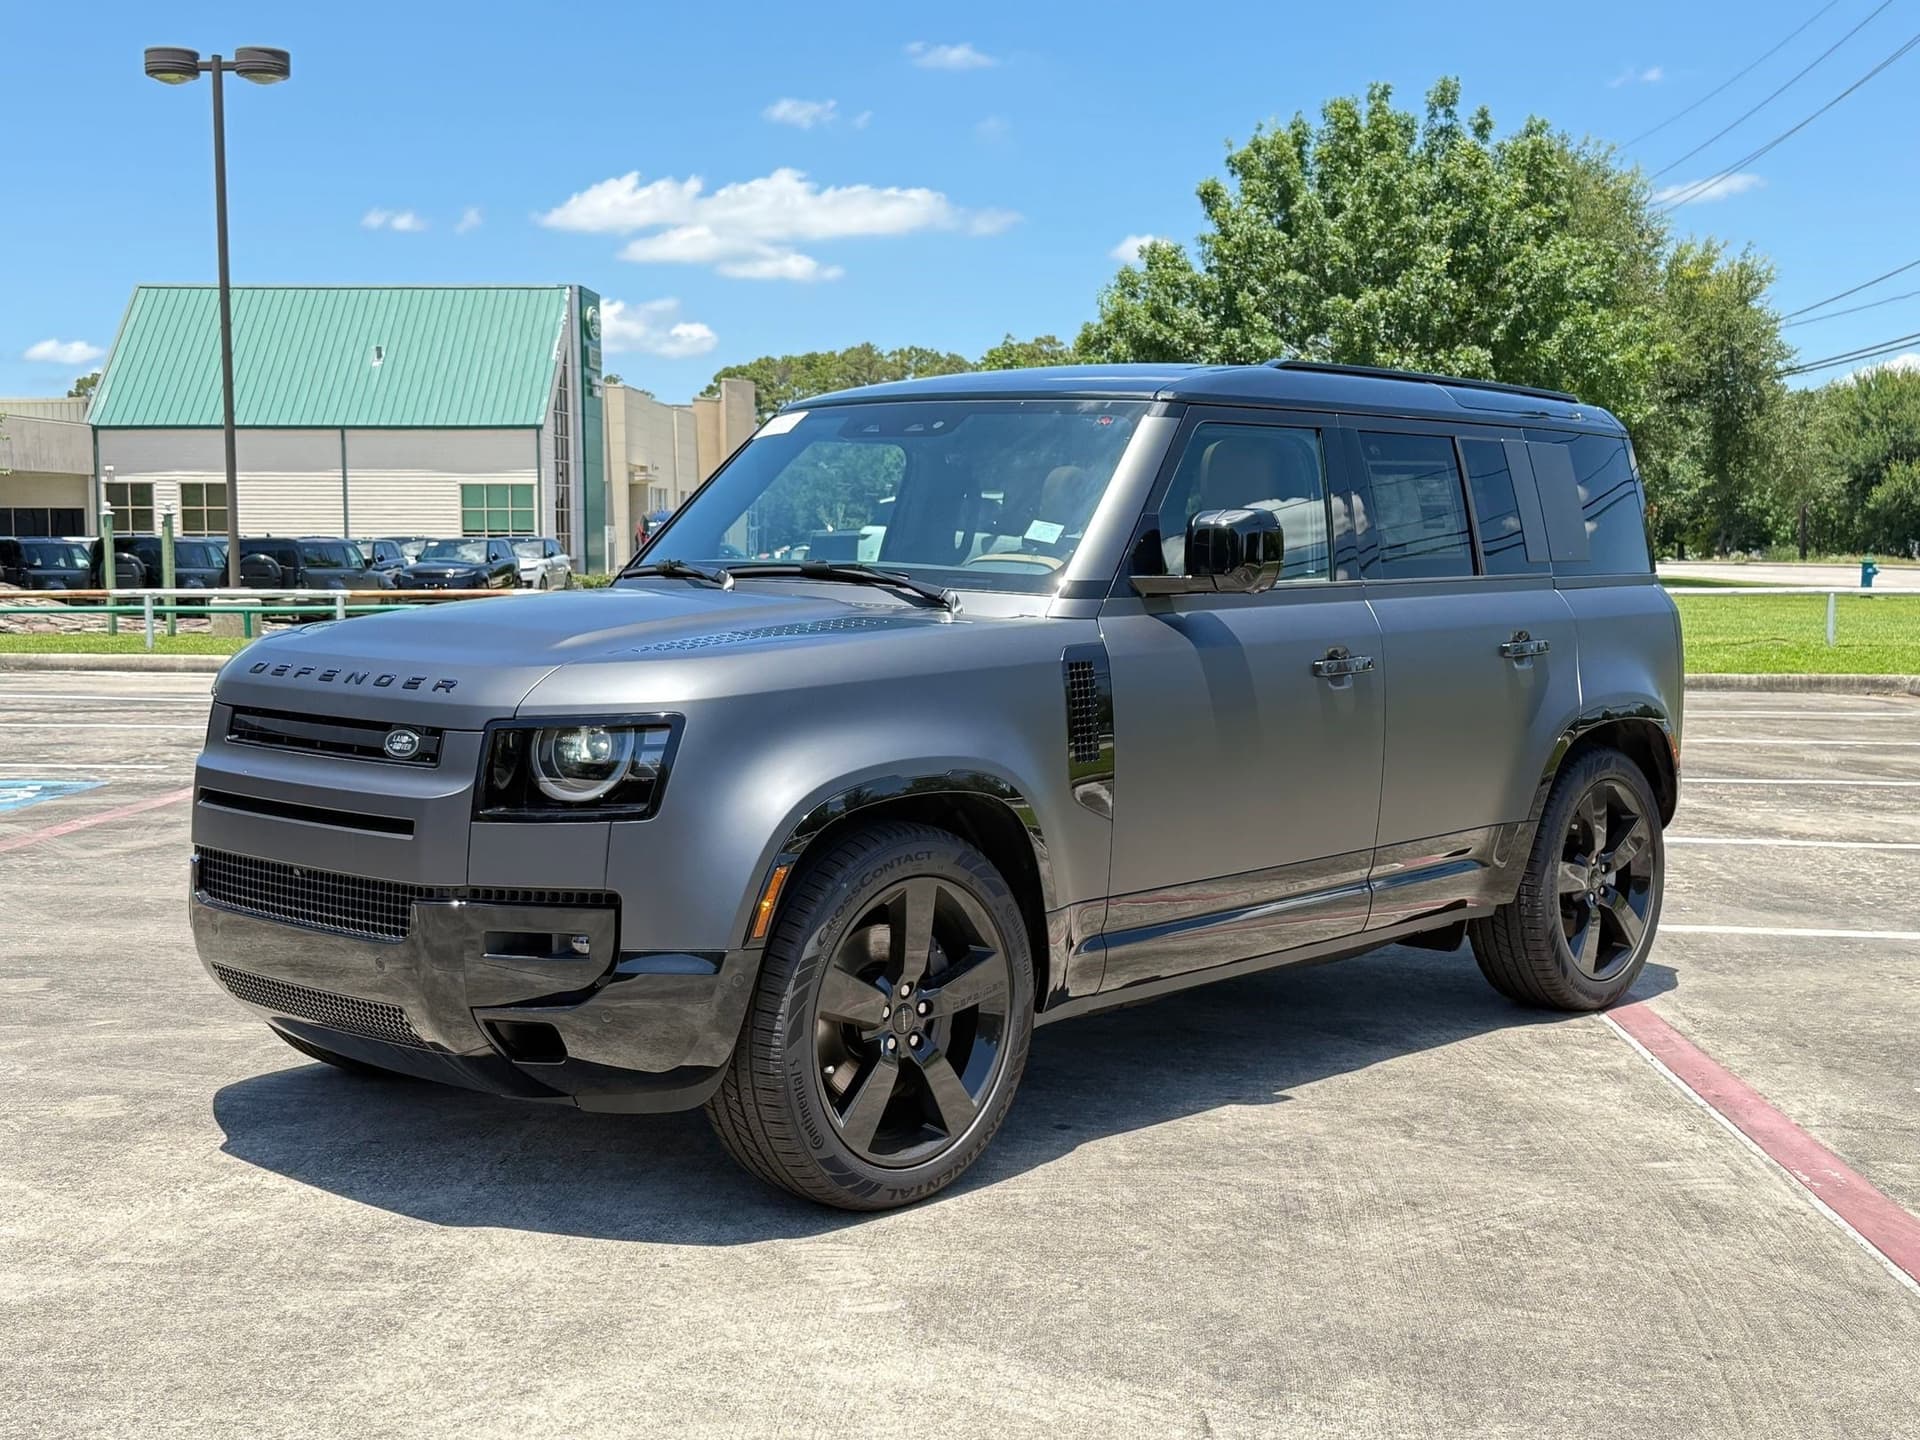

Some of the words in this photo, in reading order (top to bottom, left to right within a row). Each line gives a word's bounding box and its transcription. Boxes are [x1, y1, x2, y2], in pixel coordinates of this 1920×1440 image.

[249, 661, 458, 693] DEFENDER
[392, 735, 412, 743] LAND
[389, 742, 412, 751] ROVER
